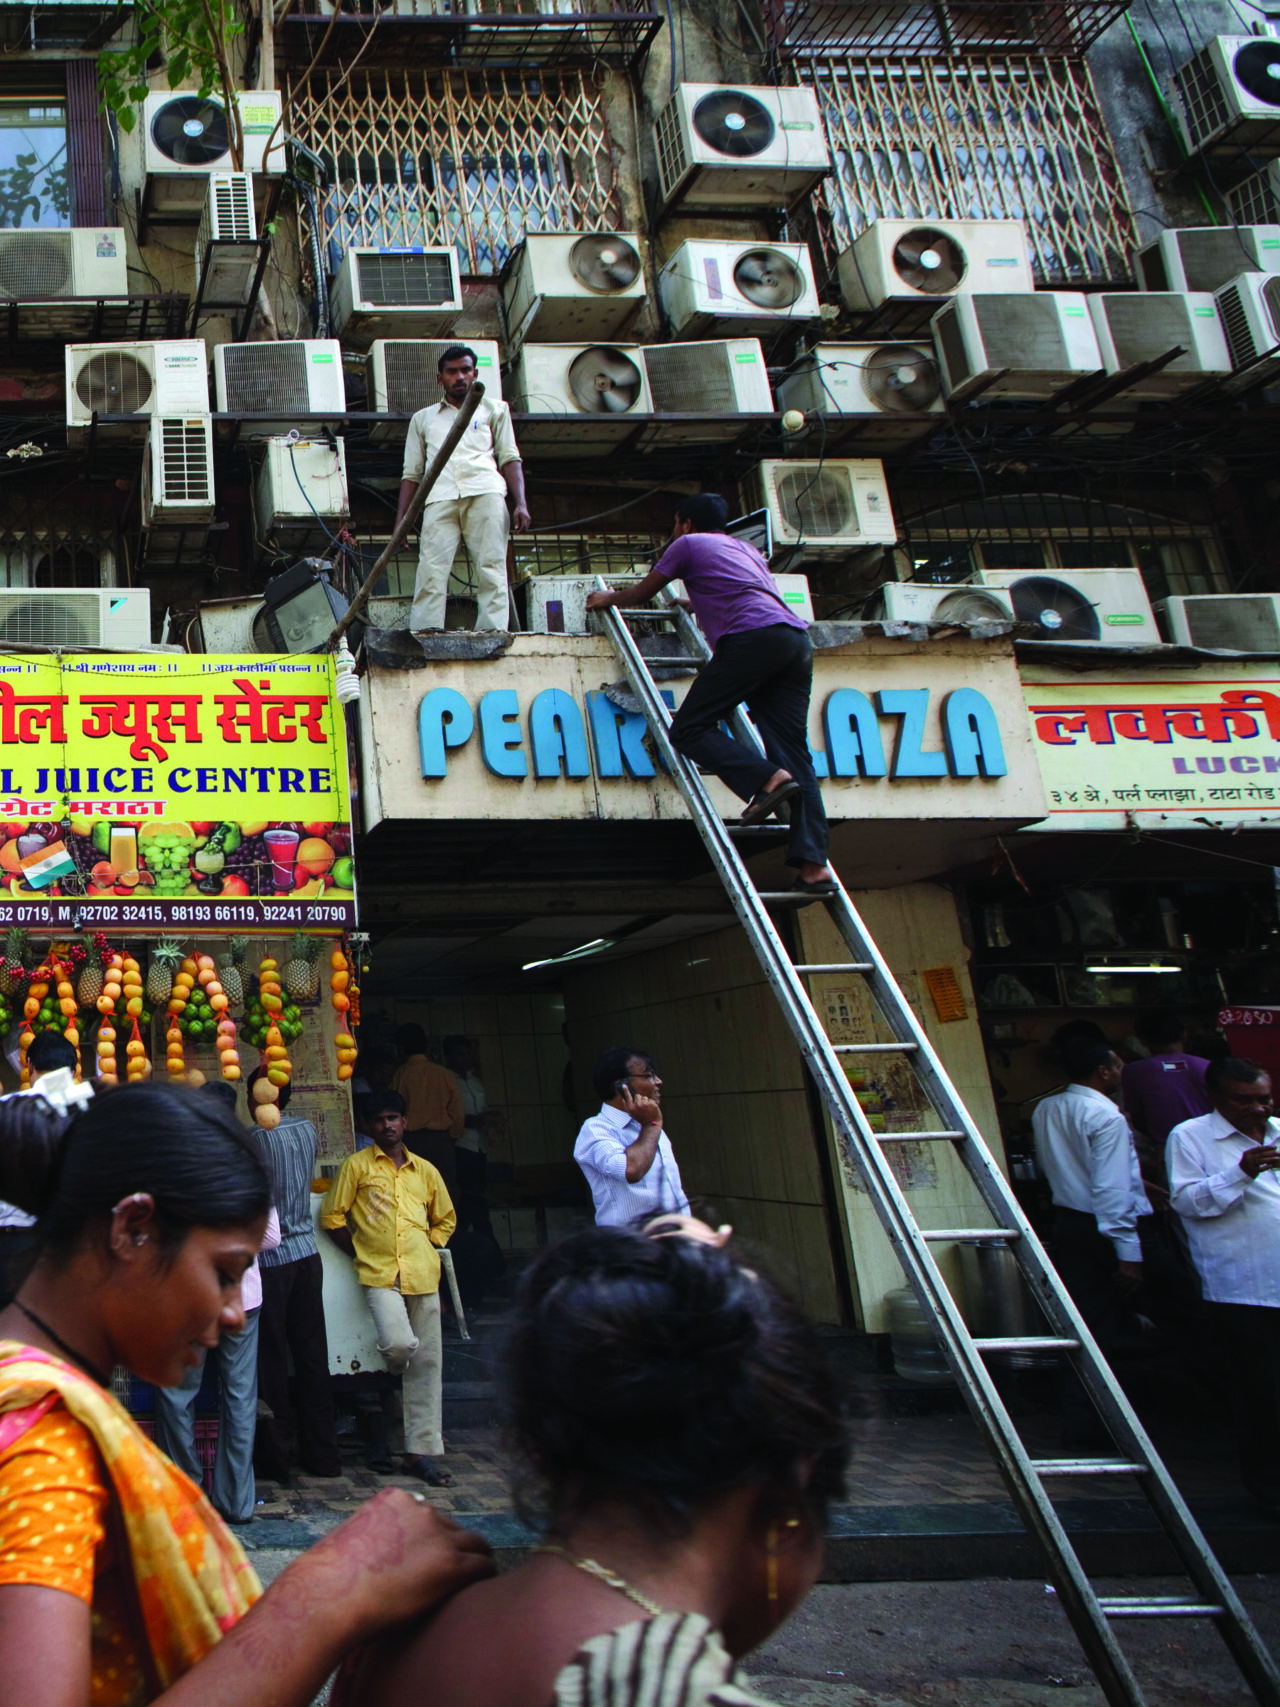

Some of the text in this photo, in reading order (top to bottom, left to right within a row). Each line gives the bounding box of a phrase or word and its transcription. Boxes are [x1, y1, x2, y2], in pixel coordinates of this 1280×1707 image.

[75, 662, 89, 673] श्री
[91, 662, 135, 672] गणेशाय
[214, 664, 233, 673] जय
[279, 664, 311, 673] प्रसन्न
[80, 695, 202, 763] ज्यूस
[214, 679, 328, 744] सेंटर
[1028, 689, 1280, 746] लक्की
[417, 687, 1008, 780] PEAR AZA
[35, 767, 154, 794] JUICE
[167, 767, 332, 794] CENTRE
[1112, 784, 1140, 802] पर्ल
[1208, 788, 1242, 801] टाटा
[1245, 782, 1275, 801] रोड
[0, 797, 57, 817] ग्रेट
[68, 800, 167, 816] मराठा
[17, 907, 54, 924] 0719,
[80, 906, 118, 921] 92702
[122, 906, 167, 923] 32415,
[171, 906, 211, 921] 98193
[214, 906, 259, 923] 66119,
[263, 906, 302, 921] 92241
[307, 906, 346, 921] 20790
